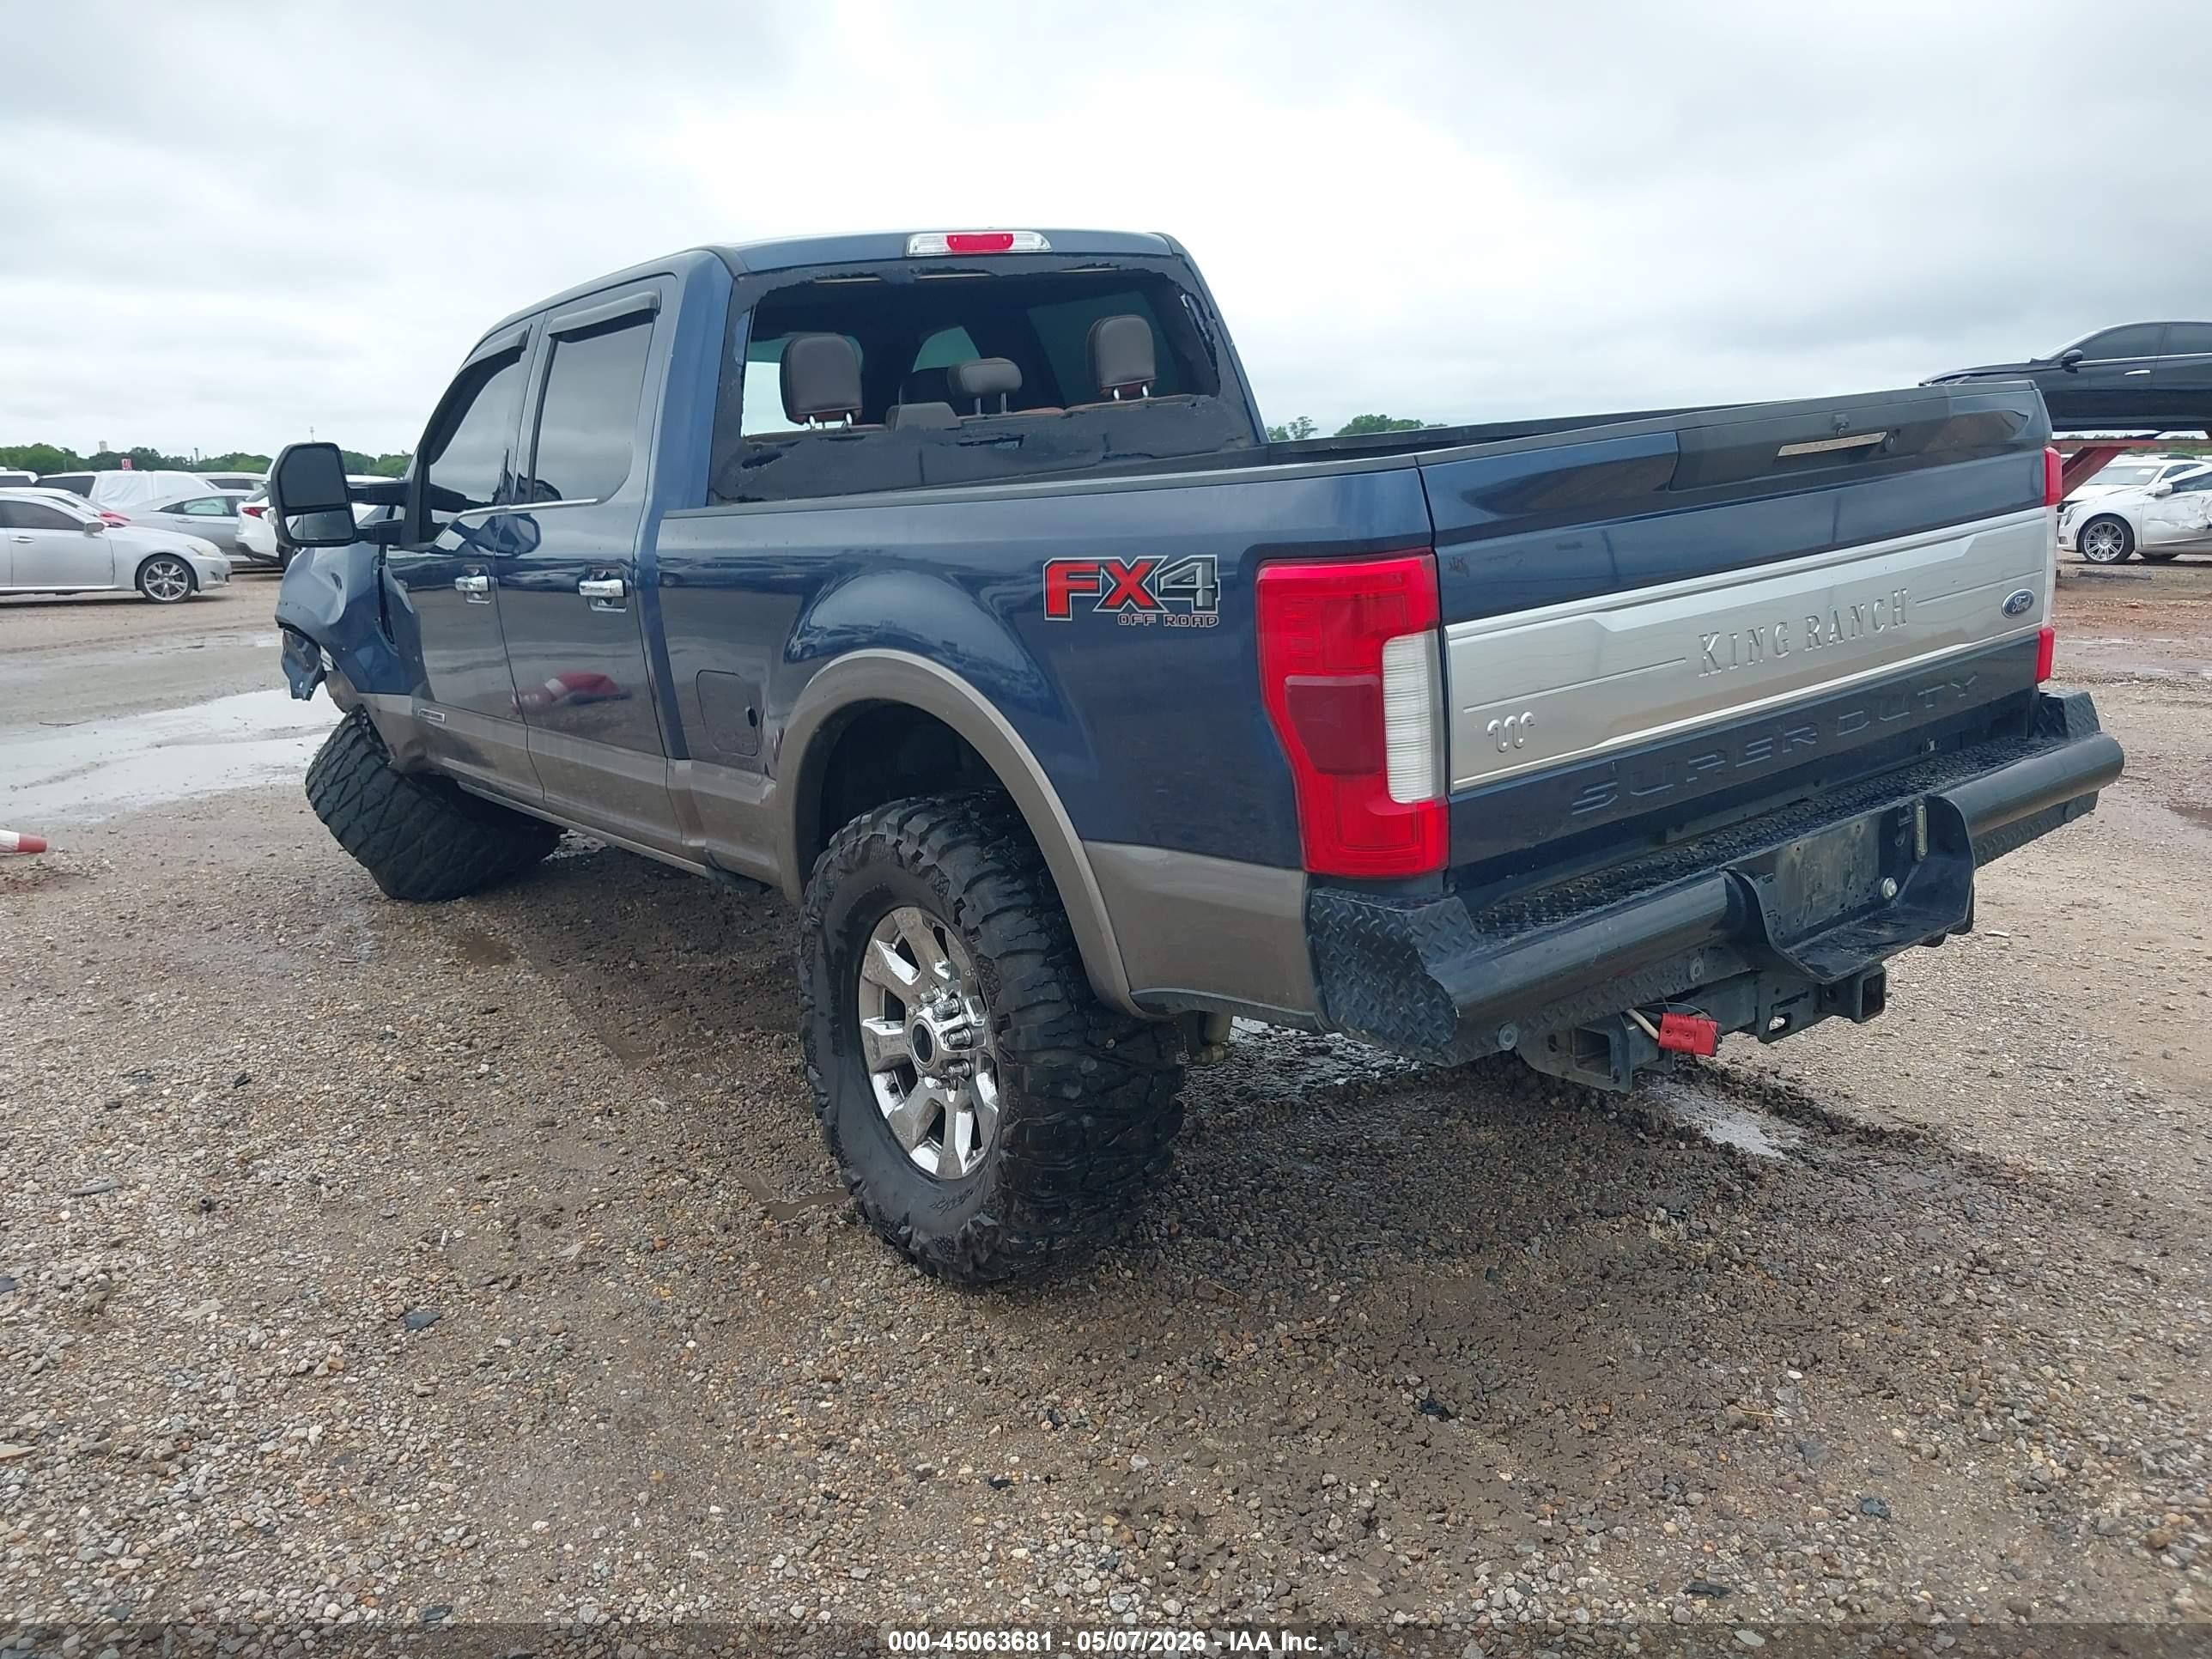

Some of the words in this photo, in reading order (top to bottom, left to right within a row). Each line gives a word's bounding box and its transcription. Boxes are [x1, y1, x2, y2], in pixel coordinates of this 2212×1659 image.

[1043, 555, 1220, 621] FX4
[1117, 613, 1157, 627] OFF
[1163, 613, 1219, 628] ROAD
[1698, 621, 1790, 678] KING
[1804, 587, 1908, 652] RANCH
[1571, 720, 1819, 815] SUPER
[1837, 675, 1978, 737] DUTY
